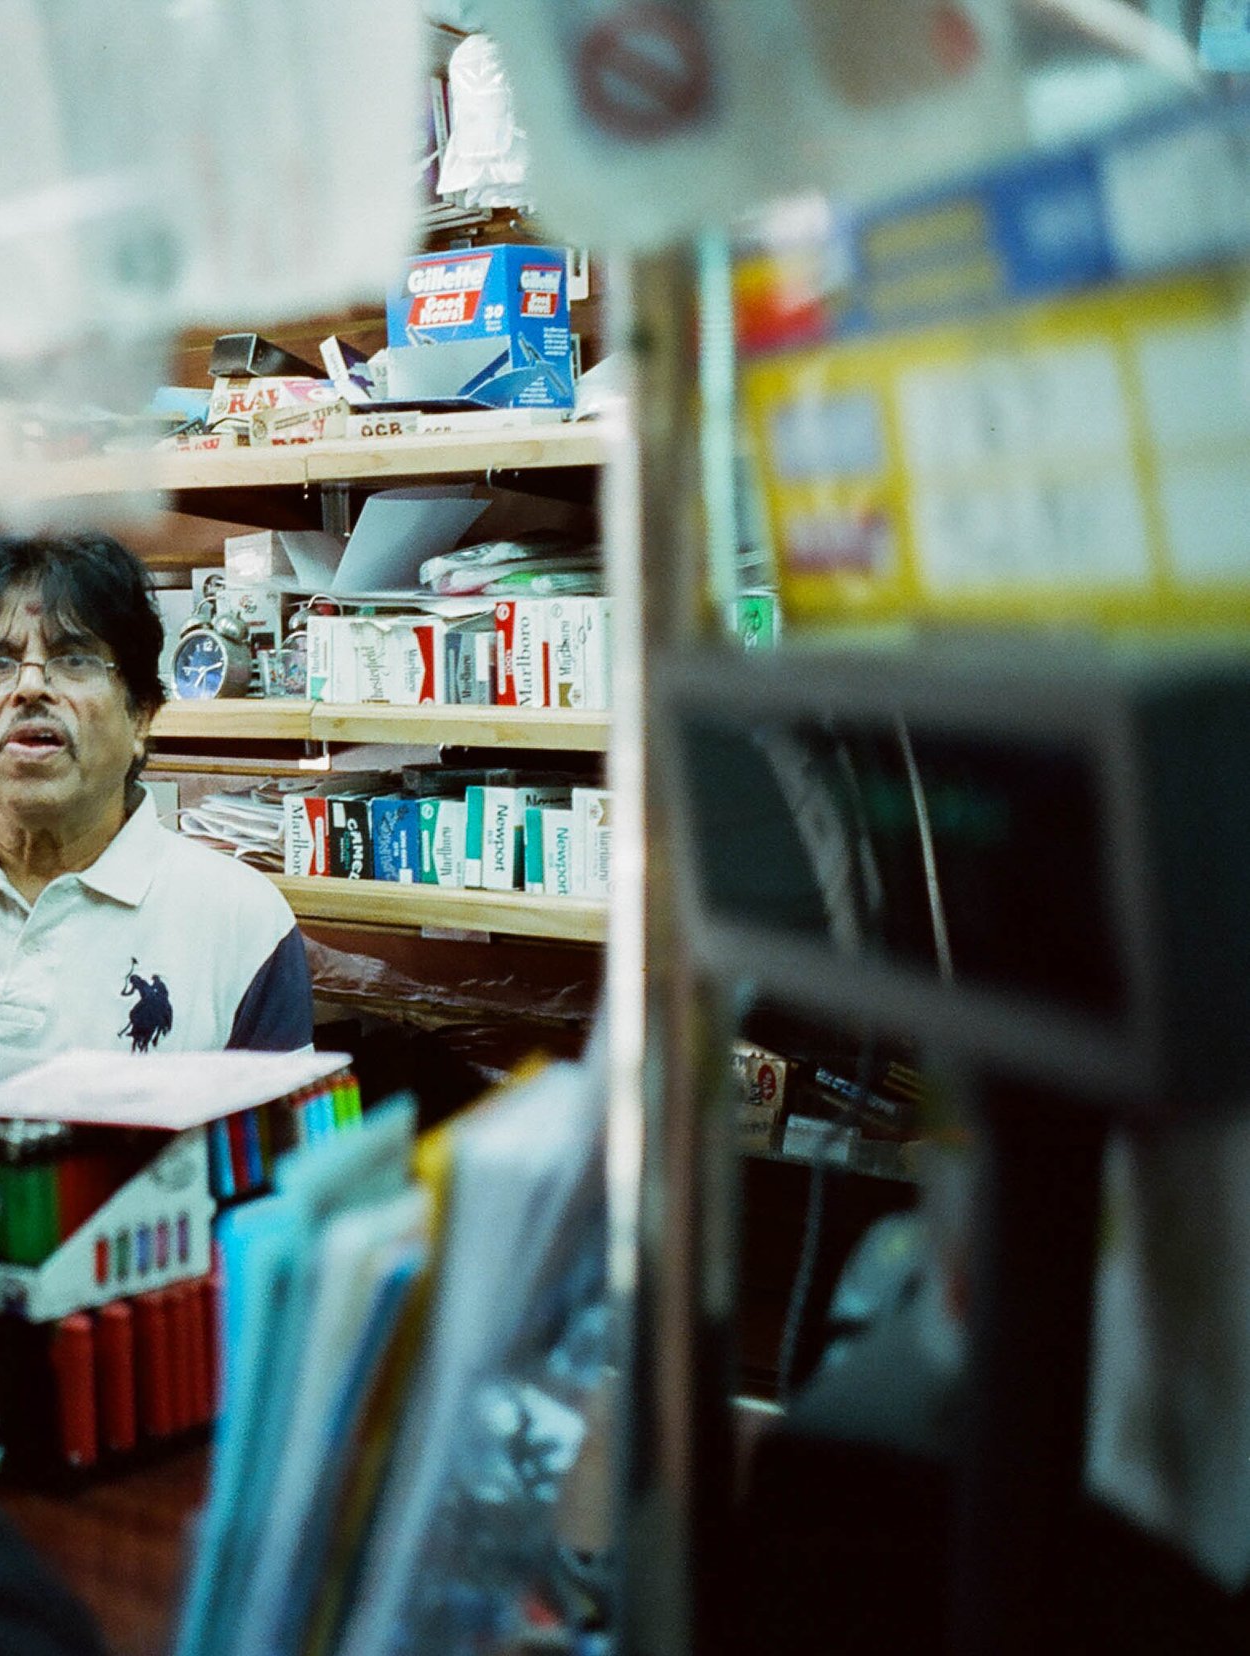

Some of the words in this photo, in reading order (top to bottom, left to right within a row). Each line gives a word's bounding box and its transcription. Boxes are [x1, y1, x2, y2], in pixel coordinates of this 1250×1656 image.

[407, 263, 484, 294] Gillette
[520, 269, 559, 291] Gillette
[419, 304, 465, 325] News!
[425, 293, 467, 310] Good
[313, 403, 342, 419] TIPS
[516, 616, 532, 706] Marlboro
[347, 817, 364, 880] CAMEL
[436, 826, 452, 876] Marlboro
[494, 804, 508, 872] Newport
[556, 827, 570, 896] Newport
